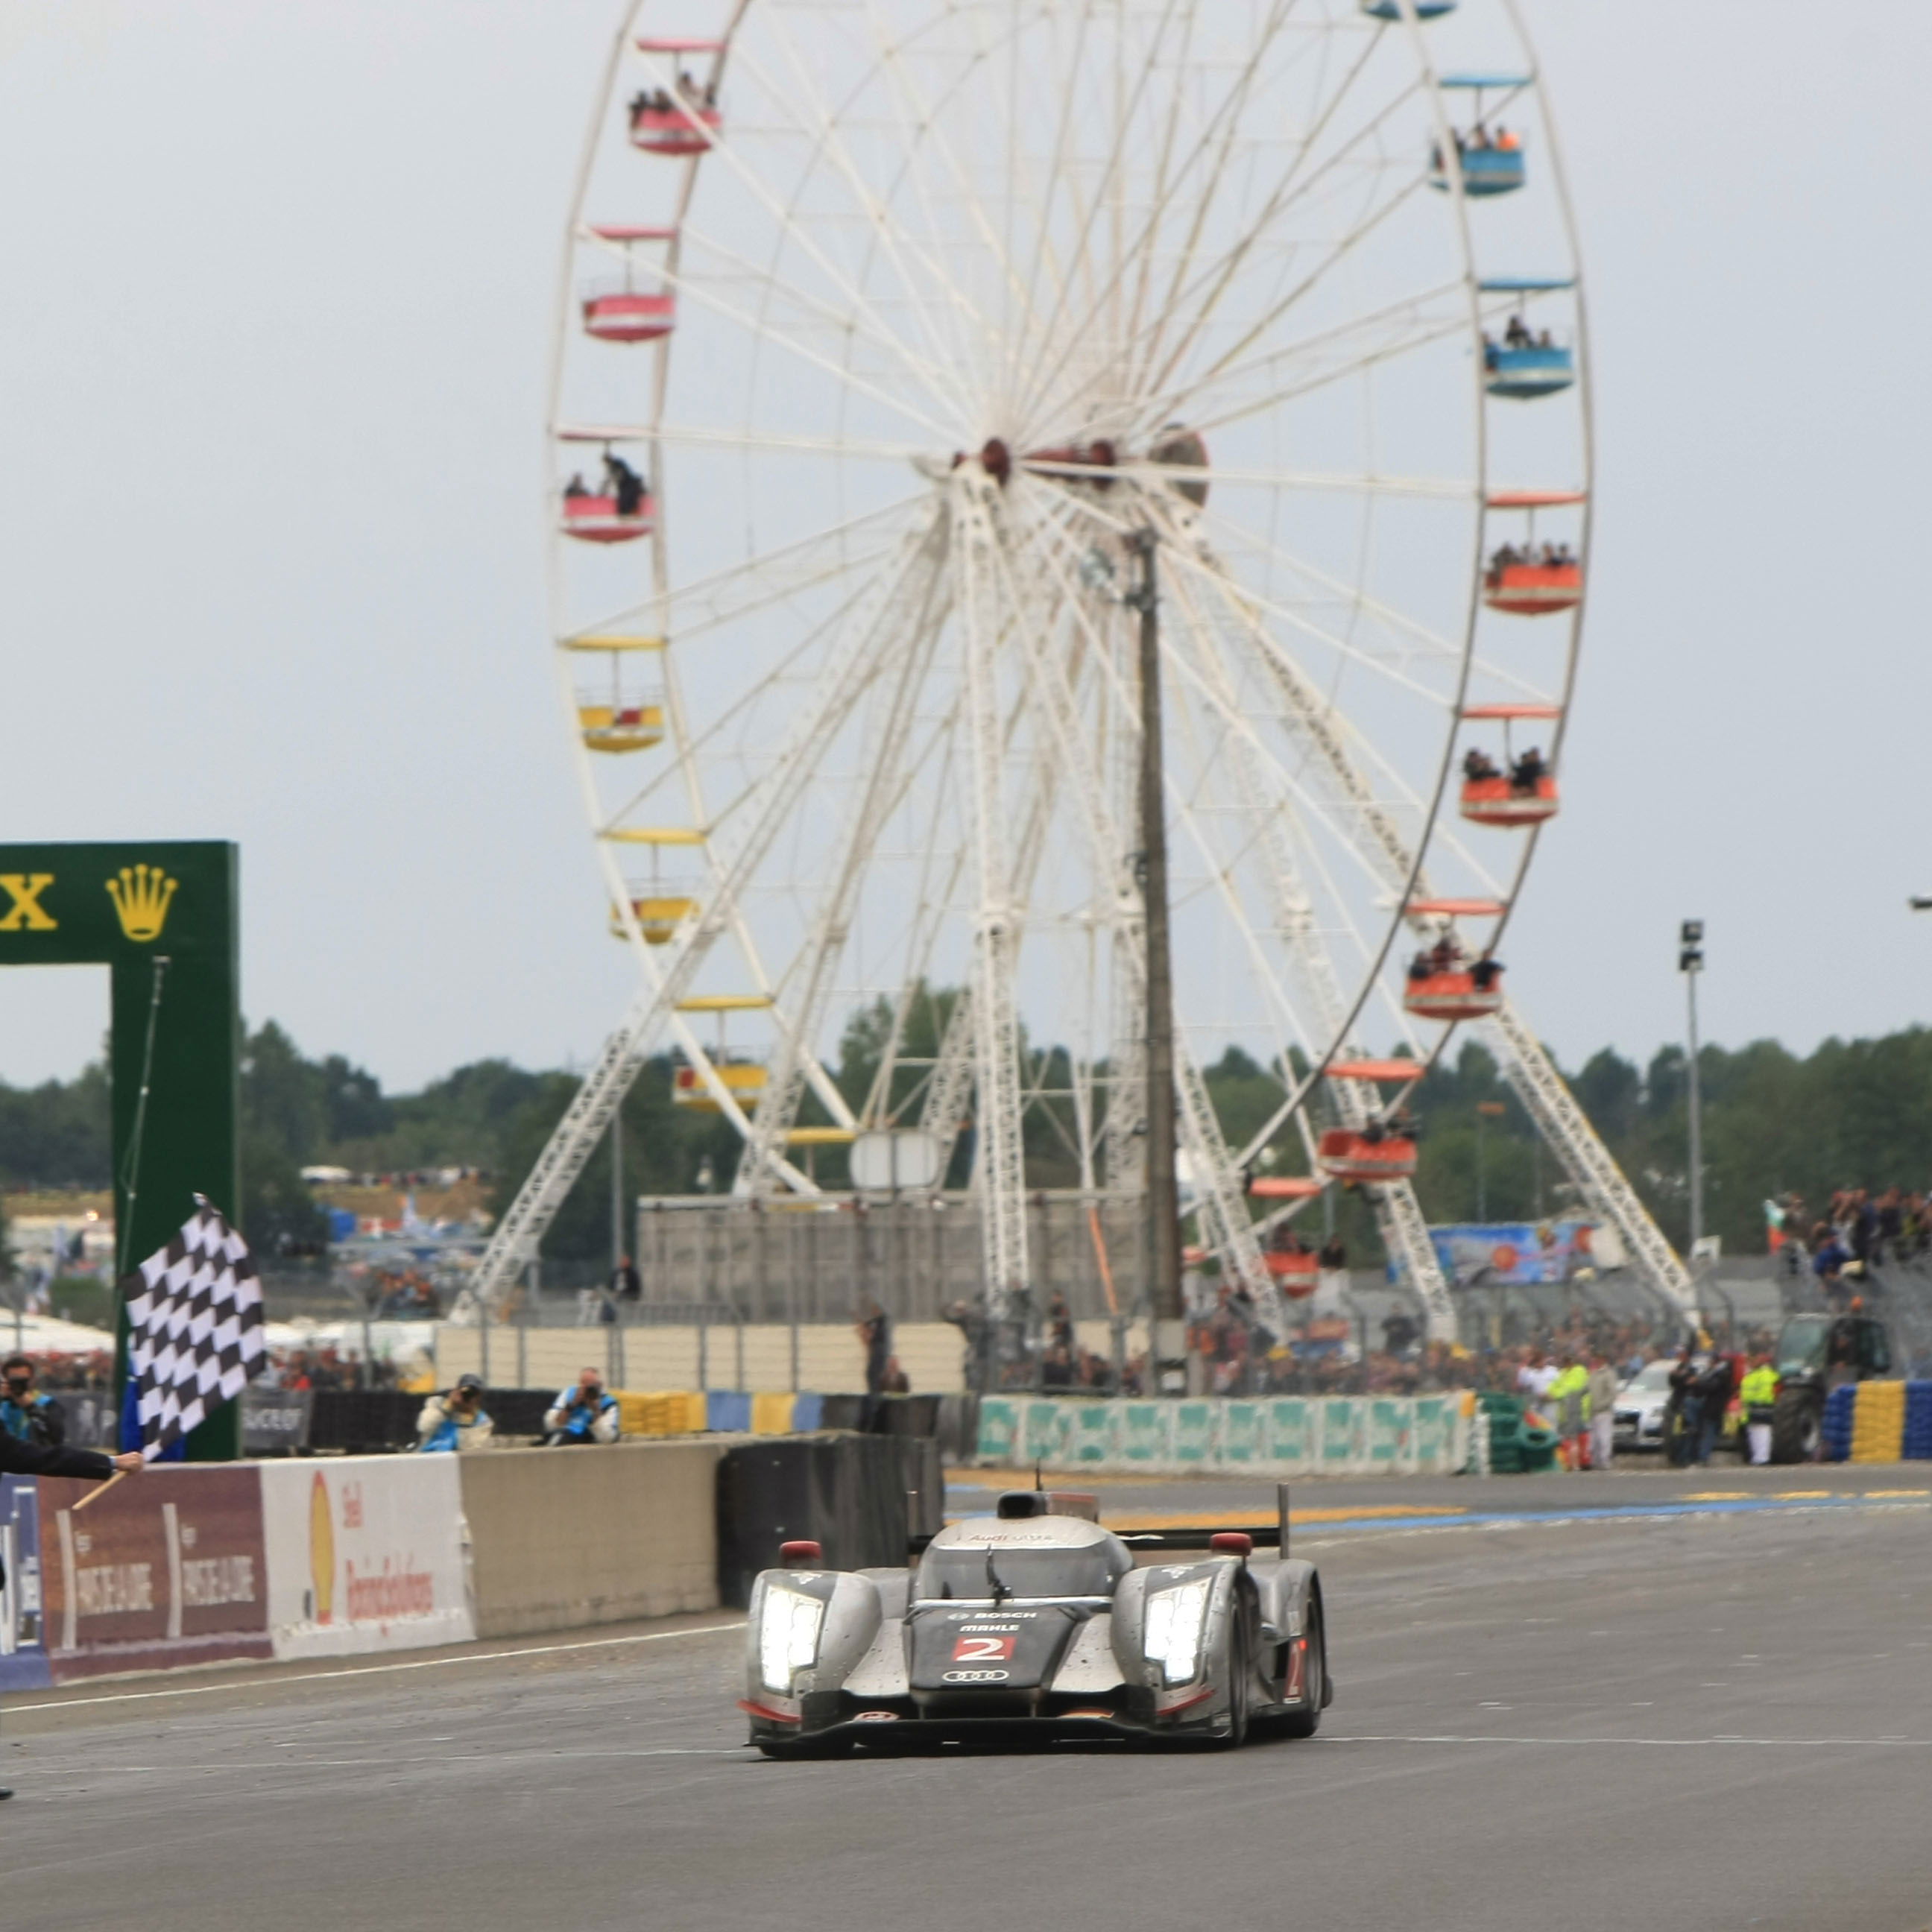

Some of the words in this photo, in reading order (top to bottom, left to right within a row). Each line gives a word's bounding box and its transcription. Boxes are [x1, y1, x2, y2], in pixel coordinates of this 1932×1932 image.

[0, 874, 59, 931] X
[970, 1533, 1008, 1541] Audi
[959, 1624, 1020, 1632] MAHLE
[956, 1638, 1006, 1661] 2
